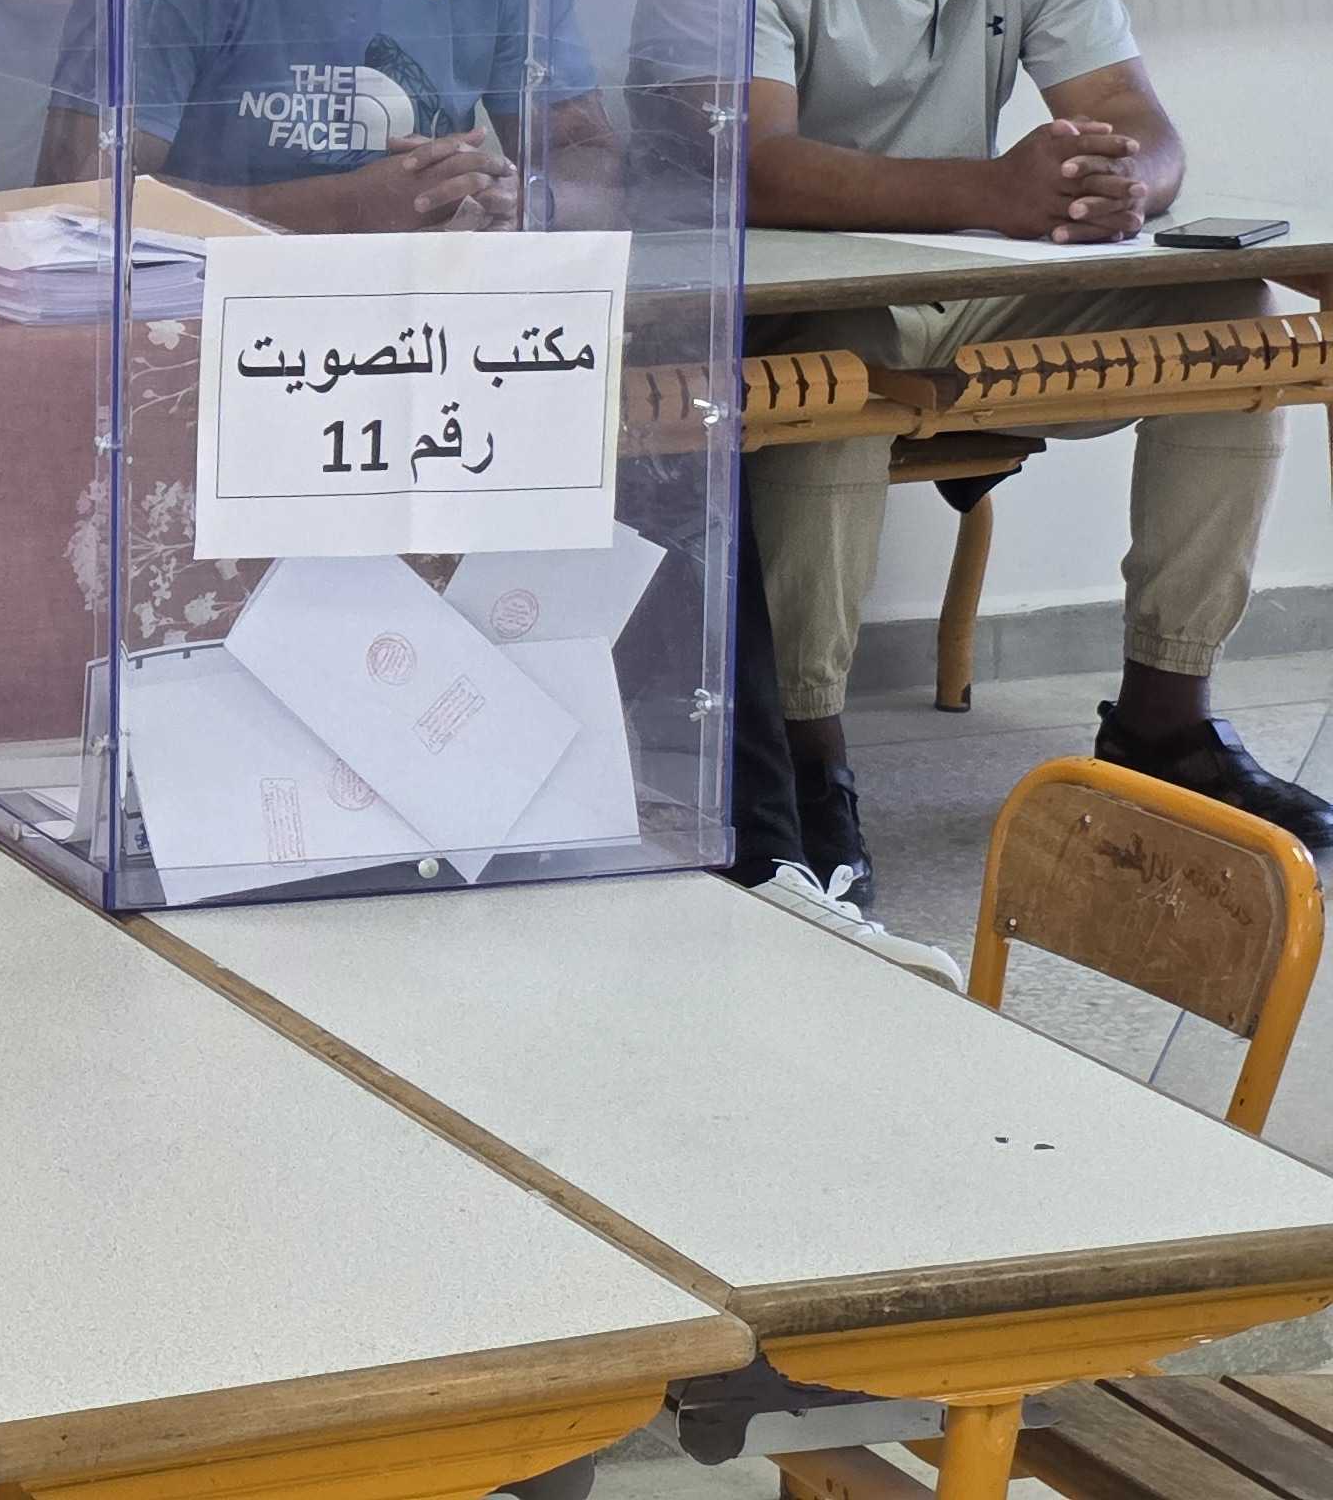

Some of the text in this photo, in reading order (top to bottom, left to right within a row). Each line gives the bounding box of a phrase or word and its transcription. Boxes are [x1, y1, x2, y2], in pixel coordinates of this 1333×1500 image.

[289, 64, 354, 94] THE
[238, 91, 352, 122] NORTH
[268, 121, 351, 151] FACE
[236, 321, 596, 394] مكتب التصويت
[321, 400, 494, 484] رقم 11
